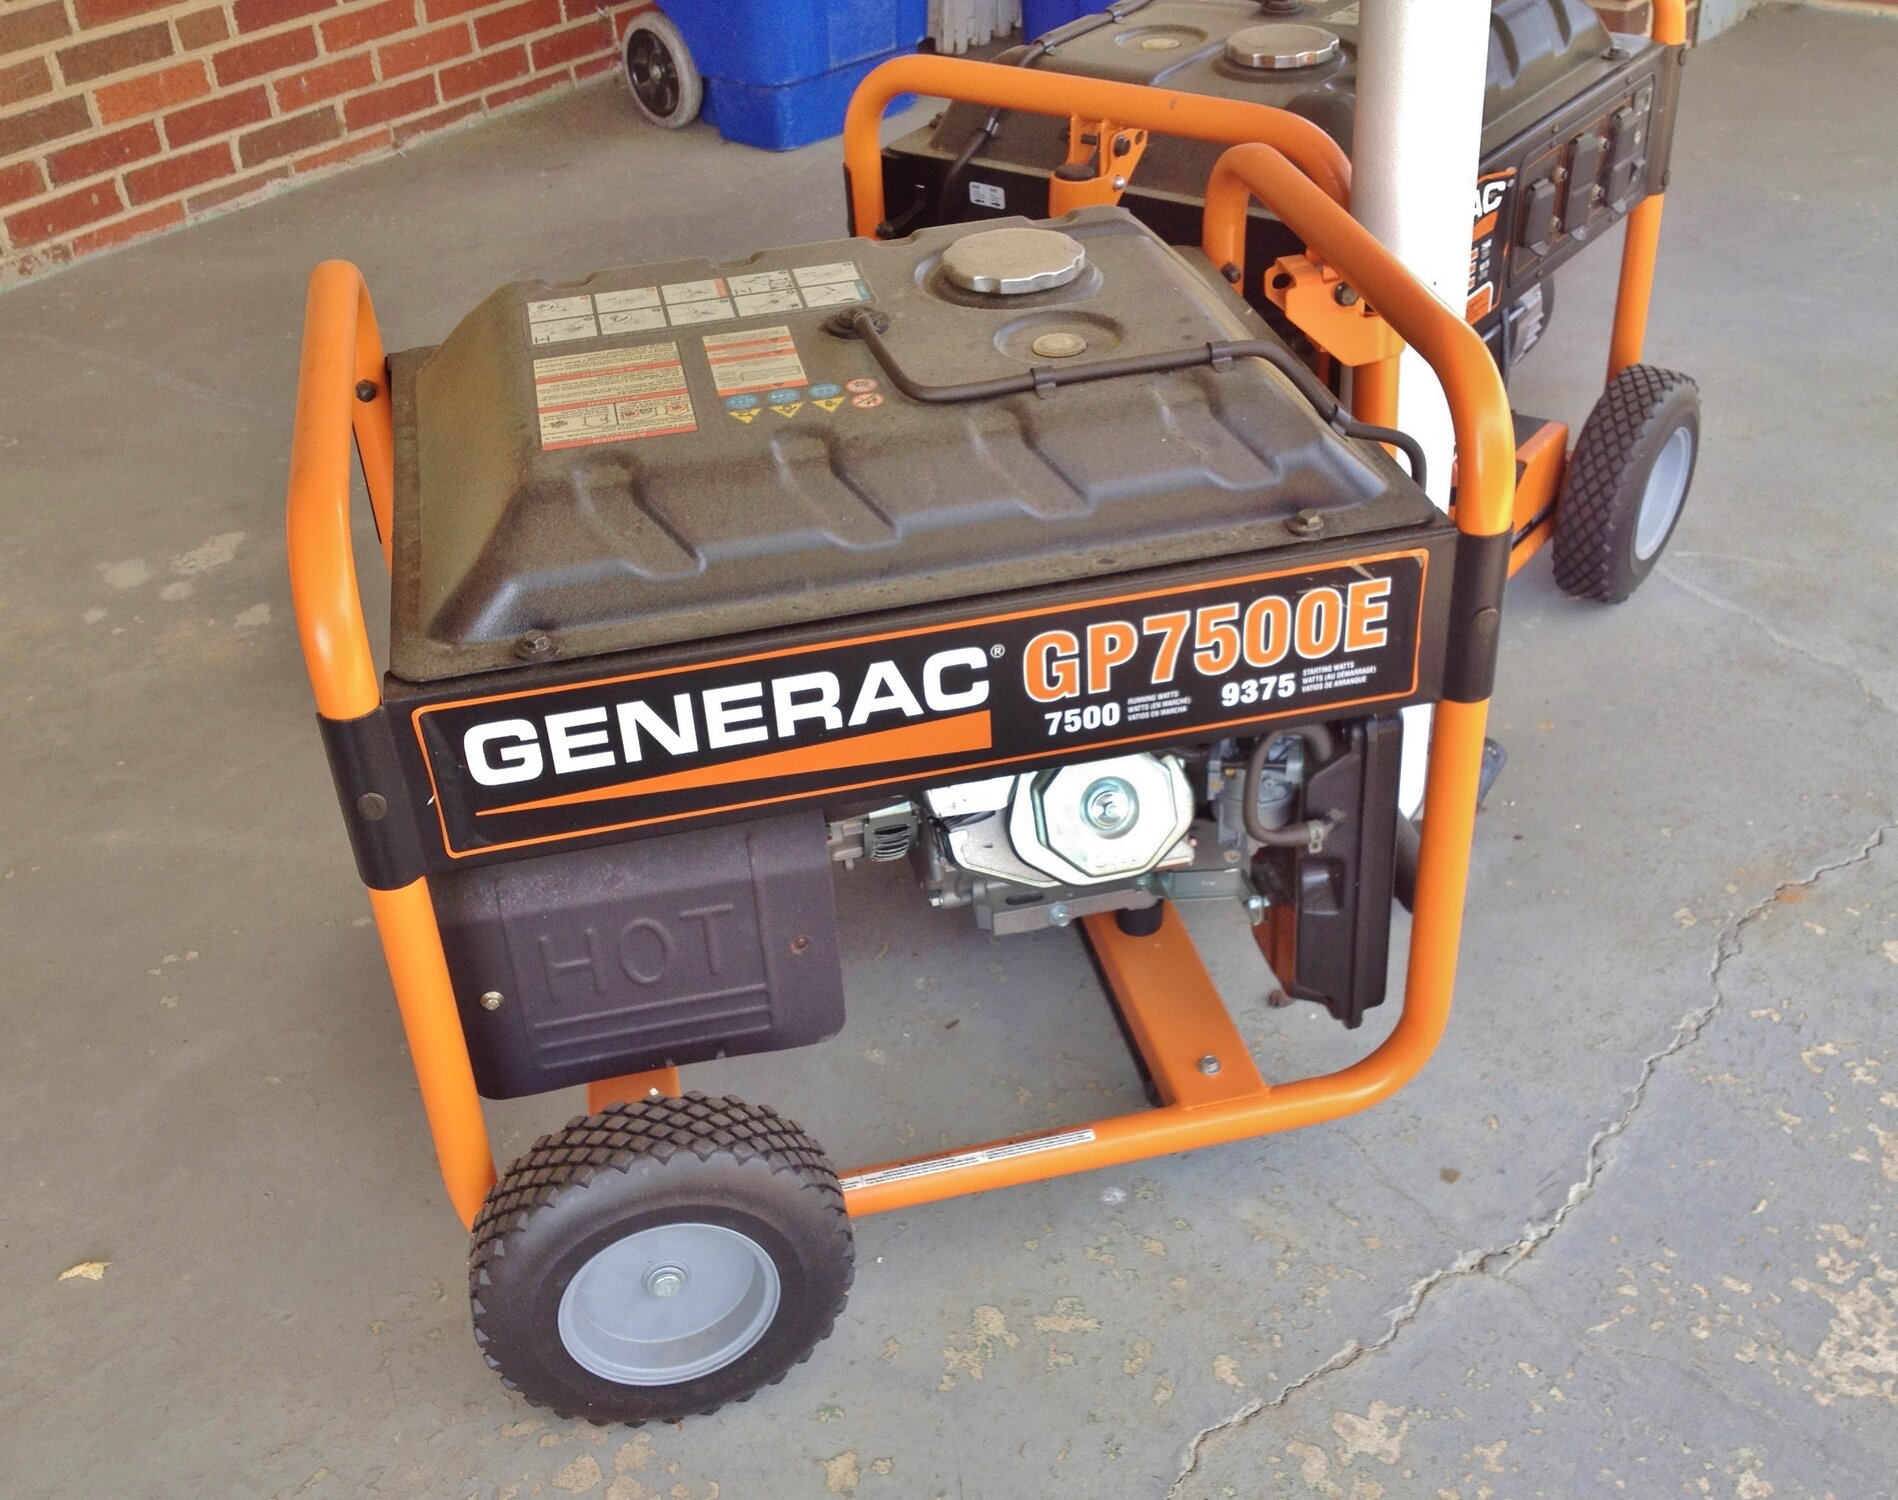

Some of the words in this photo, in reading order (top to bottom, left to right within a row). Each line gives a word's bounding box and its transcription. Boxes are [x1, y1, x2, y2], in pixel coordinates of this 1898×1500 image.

[1023, 577, 1392, 703] GP7500E
[1302, 664, 1333, 677] STARTING
[1333, 660, 1355, 672] WATTS
[1301, 683, 1324, 693] VATIOS
[1333, 675, 1368, 688] ARRANQUE
[1302, 674, 1324, 685] WATTS
[1157, 690, 1180, 701] WATTS
[1221, 673, 1296, 707] 9375
[1127, 703, 1150, 713] WATTS
[1044, 702, 1121, 736] 7500
[536, 903, 735, 1002] HOT
